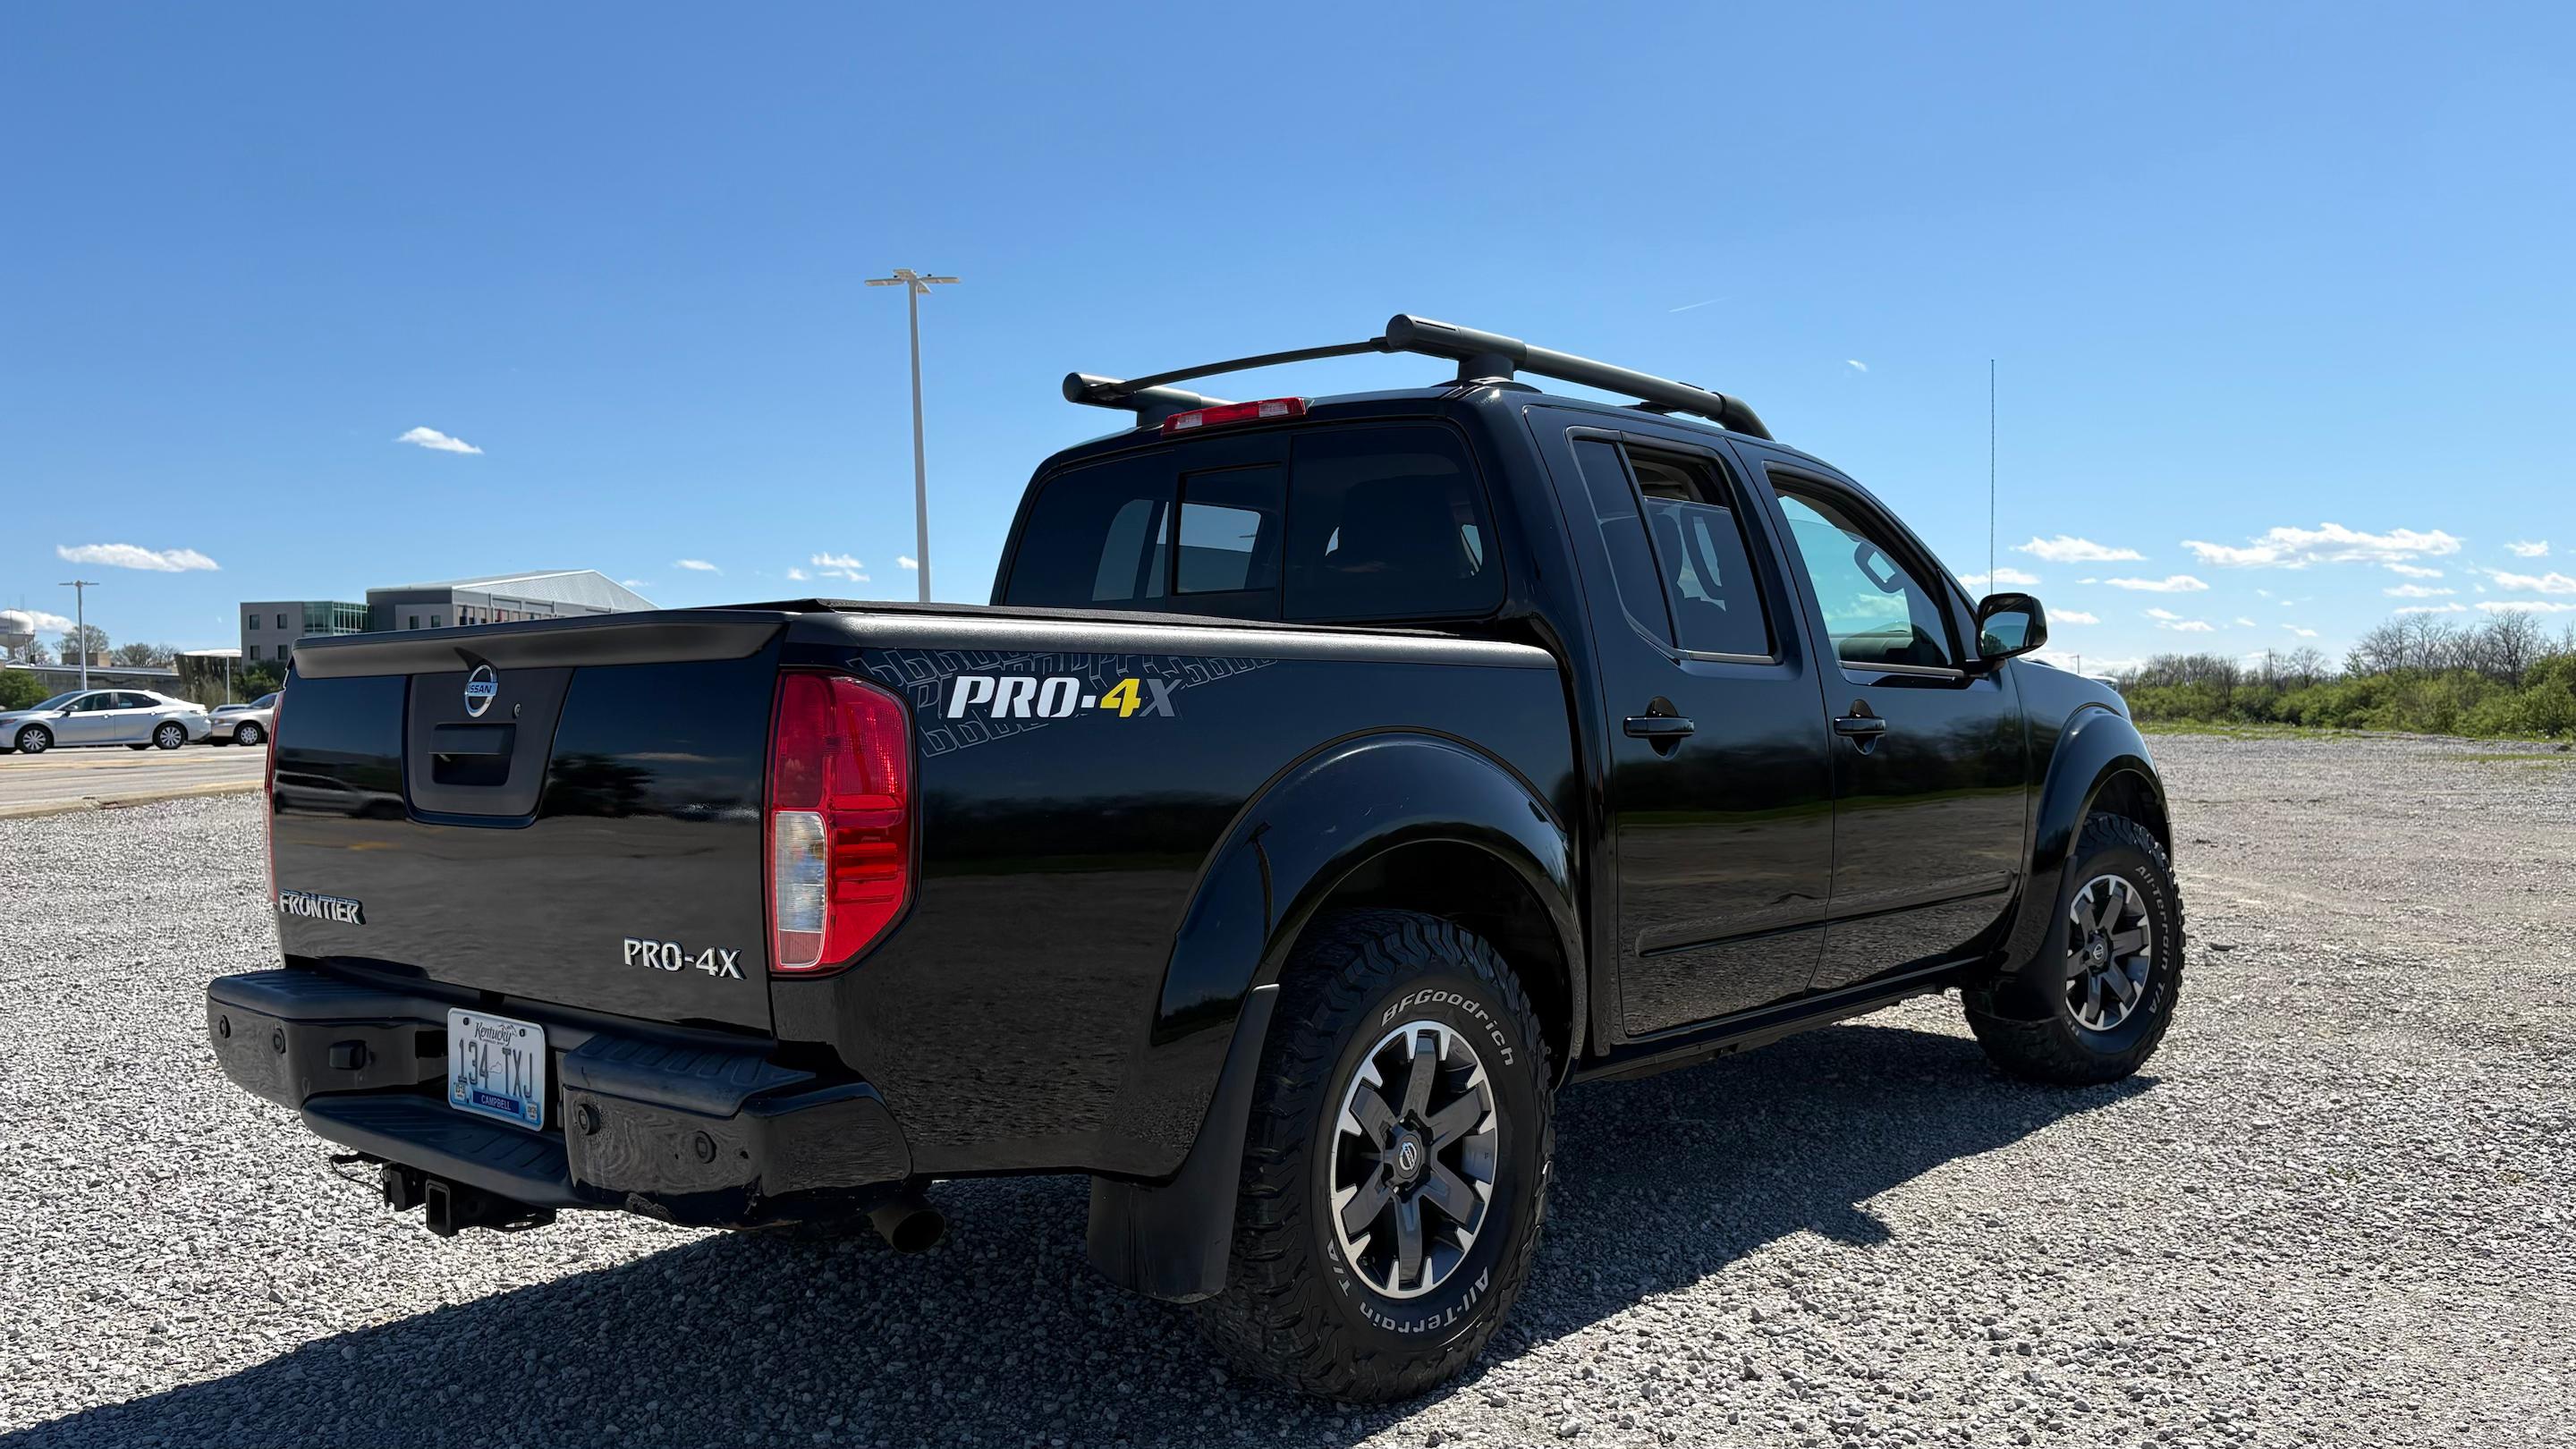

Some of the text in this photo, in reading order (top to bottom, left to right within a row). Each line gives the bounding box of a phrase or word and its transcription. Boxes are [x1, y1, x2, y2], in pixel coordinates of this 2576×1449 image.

[467, 683, 492, 693] ISSAN
[946, 675, 1182, 718] PRO-4X
[279, 890, 363, 925] FRONTIER
[2135, 866, 2170, 970] All-Terrain
[624, 937, 745, 980] PRO-4X
[475, 1021, 512, 1046] Kentucky
[1381, 988, 1514, 1066] BFGoodrich
[458, 1038, 532, 1098] 134 TXJ
[481, 1095, 512, 1111] CAMPBELL
[1327, 1238, 1489, 1334] All-Terrain T/A
